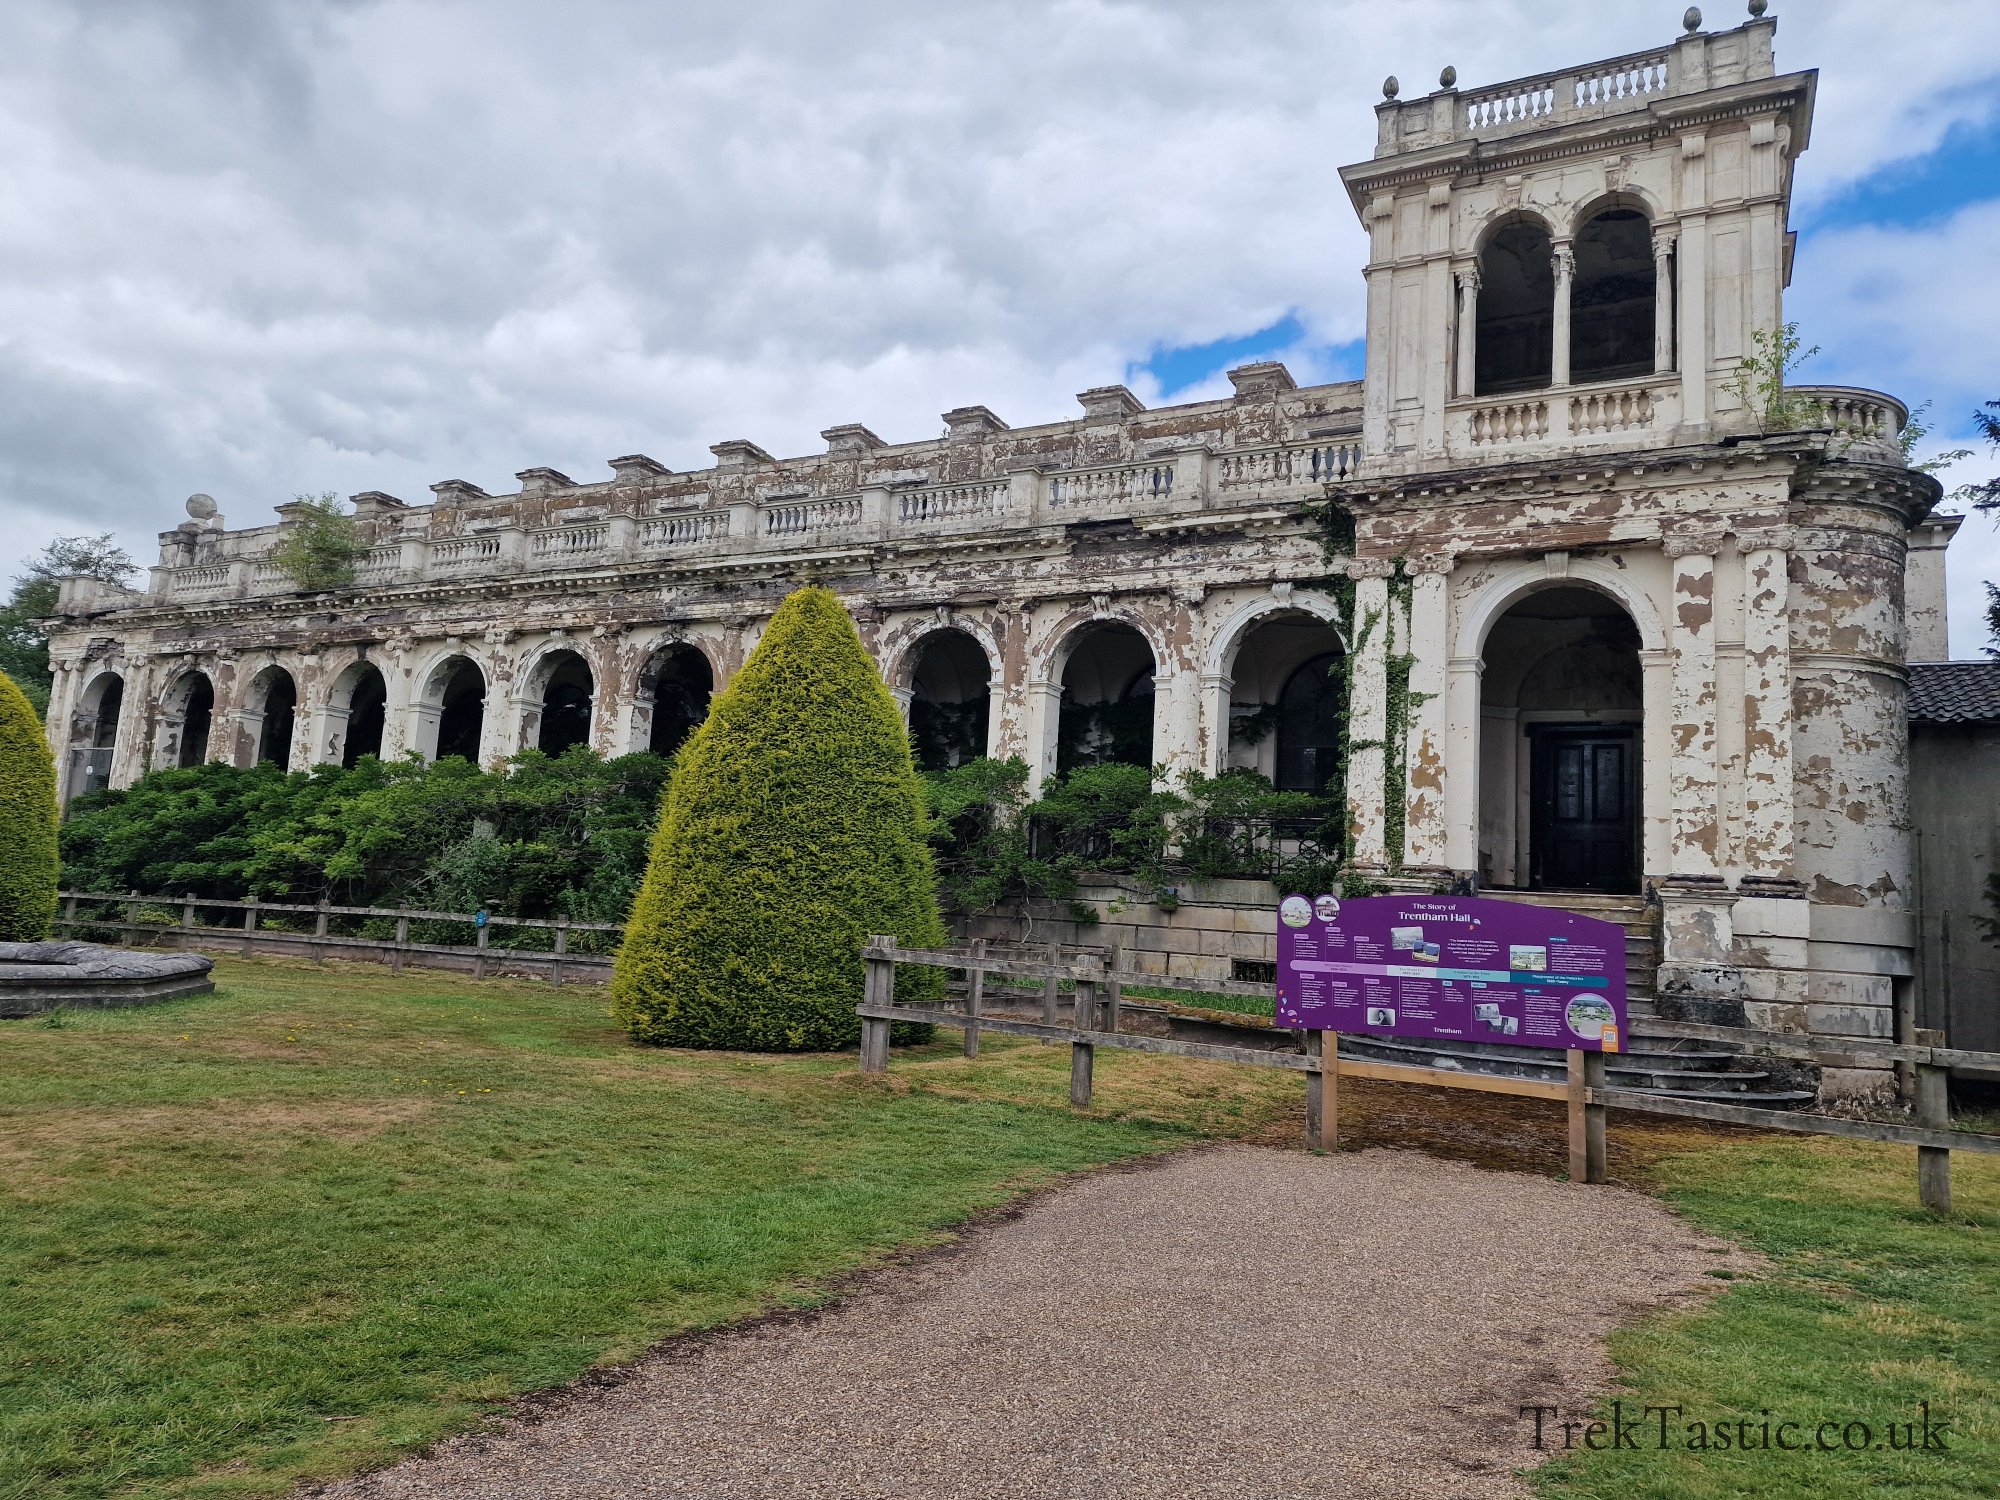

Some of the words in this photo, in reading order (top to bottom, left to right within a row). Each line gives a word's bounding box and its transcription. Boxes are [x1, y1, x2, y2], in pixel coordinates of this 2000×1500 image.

[1427, 903, 1447, 911] Story
[1398, 911, 1448, 921] Trentham
[1450, 913, 1471, 922] Hall
[1433, 1027, 1462, 1035] Trentham
